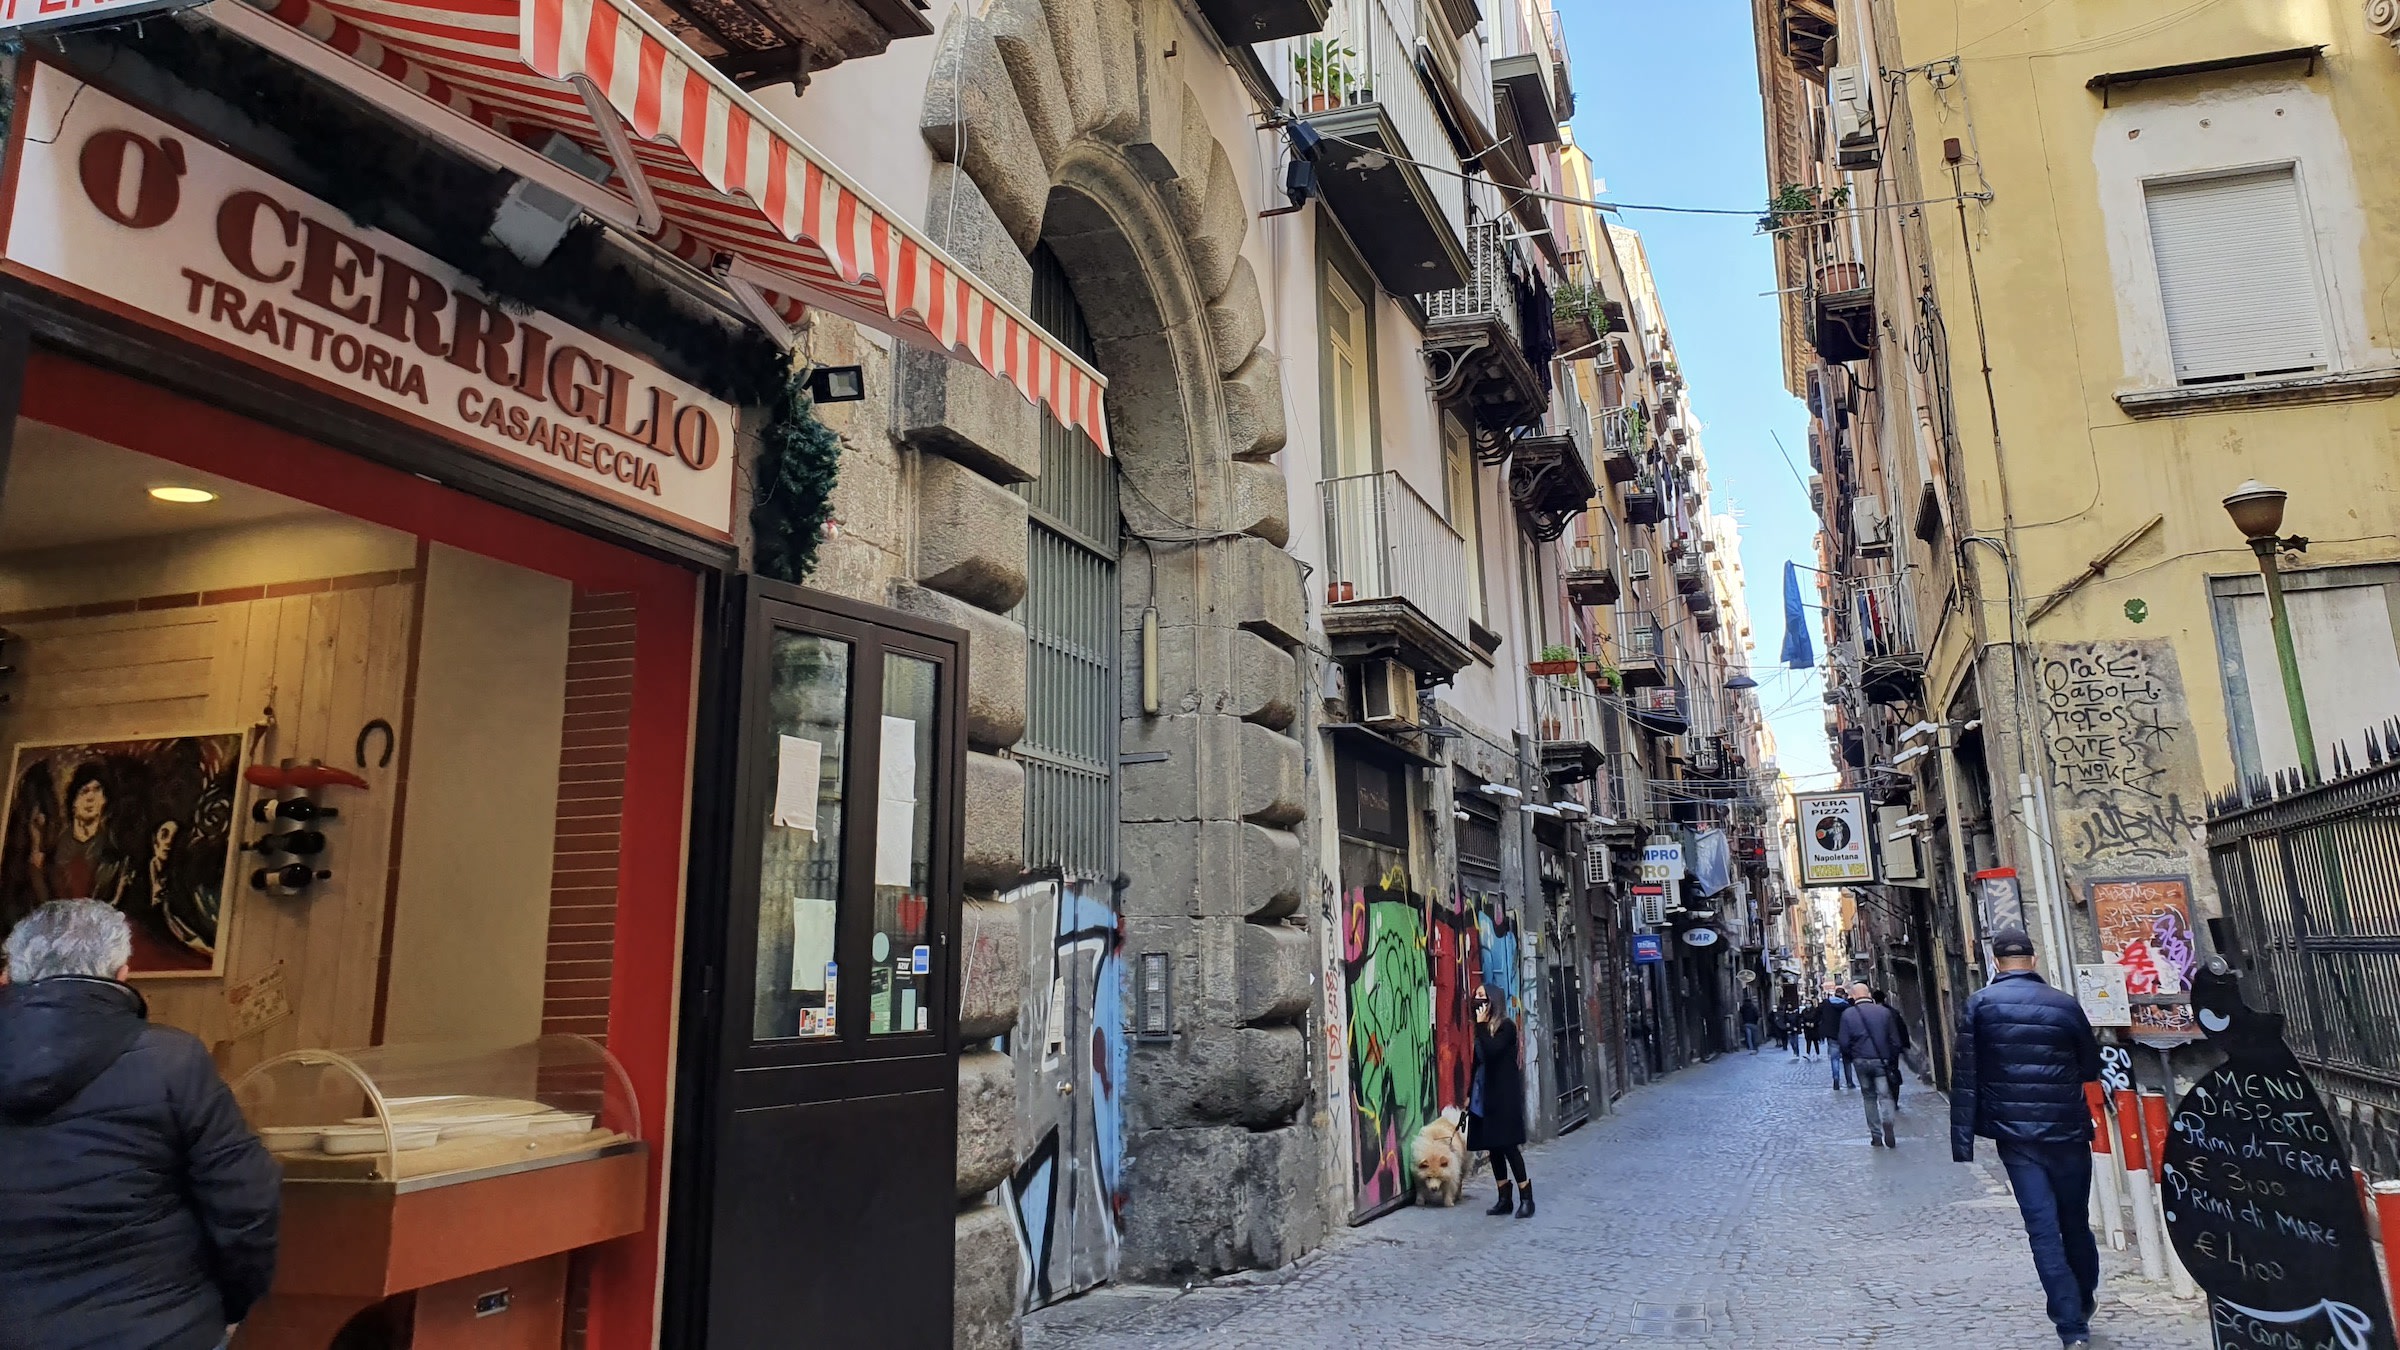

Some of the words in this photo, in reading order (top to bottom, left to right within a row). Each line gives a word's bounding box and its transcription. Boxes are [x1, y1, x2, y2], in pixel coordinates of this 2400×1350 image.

[216, 190, 720, 471] CERRIGLIO
[181, 267, 429, 405] TRATTORIA
[457, 385, 662, 497] CASARECCIA
[1620, 849, 1679, 862] COMPRO
[1814, 853, 1859, 862] Napoletana
[1631, 865, 1670, 878] ORO
[1689, 934, 1710, 942] BAR
[2214, 1070, 2304, 1101] MENÙ
[2185, 1156, 2211, 1181] €
[2242, 1132, 2267, 1160] di
[2266, 1142, 2345, 1181] TERRA
[2240, 1200, 2266, 1231] di
[2274, 1210, 2341, 1248] MARE
[2194, 1231, 2218, 1259] €
